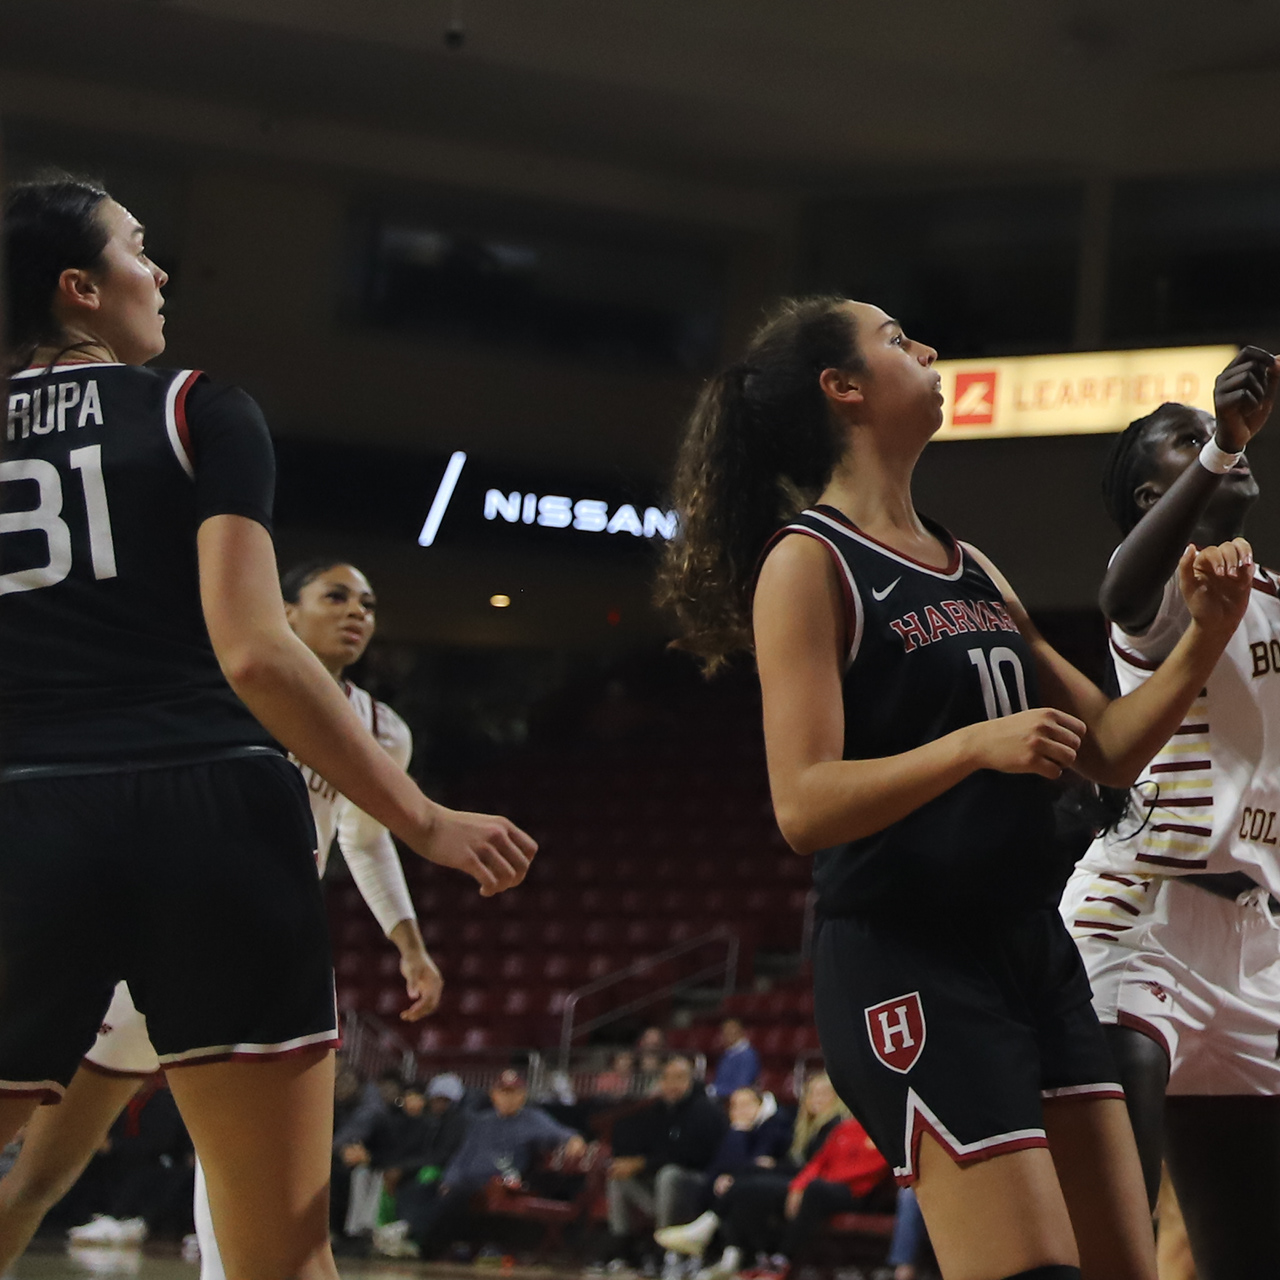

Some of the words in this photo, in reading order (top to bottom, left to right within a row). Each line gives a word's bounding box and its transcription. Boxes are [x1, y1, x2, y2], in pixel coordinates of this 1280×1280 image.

[1012, 372, 1200, 411] LEARFIELD
[483, 488, 680, 541] NISSAN
[967, 646, 1029, 721] 10
[877, 1004, 915, 1055] H
